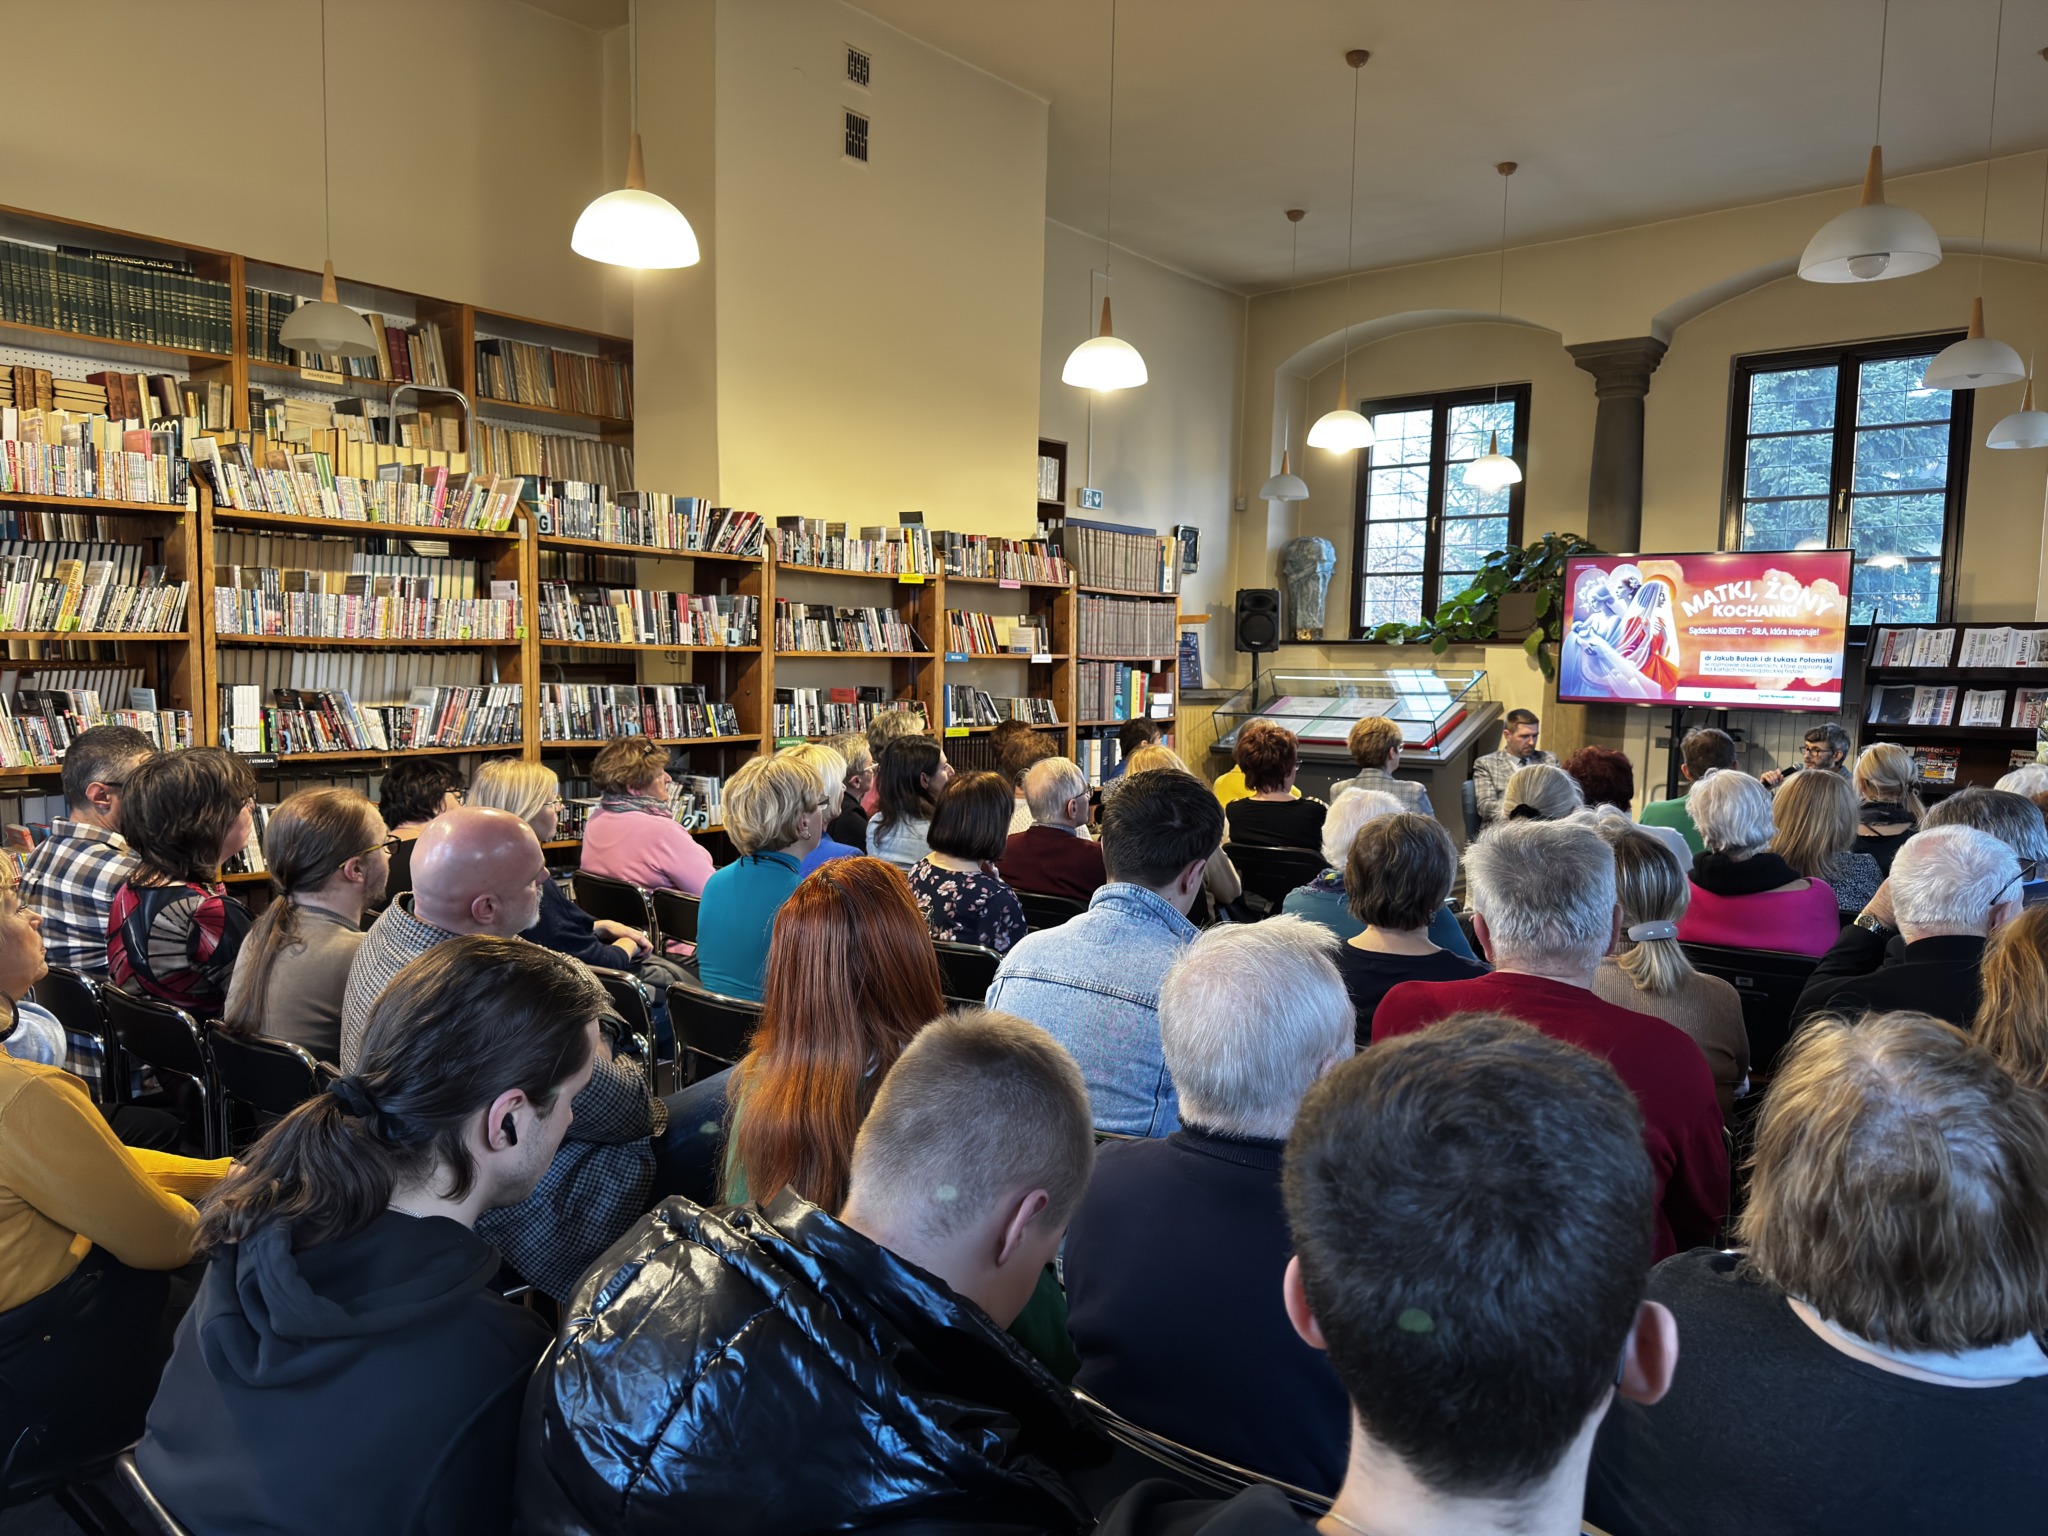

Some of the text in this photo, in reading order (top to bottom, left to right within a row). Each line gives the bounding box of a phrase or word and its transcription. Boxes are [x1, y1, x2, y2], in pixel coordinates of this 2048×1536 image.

[96, 253, 174, 269] BRITANNICA ATLAS
[539, 514, 548, 531] G
[687, 534, 697, 549] H
[1680, 577, 1835, 617] MATKI, ŻONY
[1712, 604, 1798, 617] KOCHANKI
[729, 630, 736, 644] L
[1688, 626, 1717, 636] Sądeckie
[1718, 627, 1746, 635] KOBIETY
[1751, 628, 1768, 636] SIŁA,
[1769, 628, 1787, 636] która
[1788, 628, 1820, 637] inspiruje!
[698, 813, 706, 827] P
